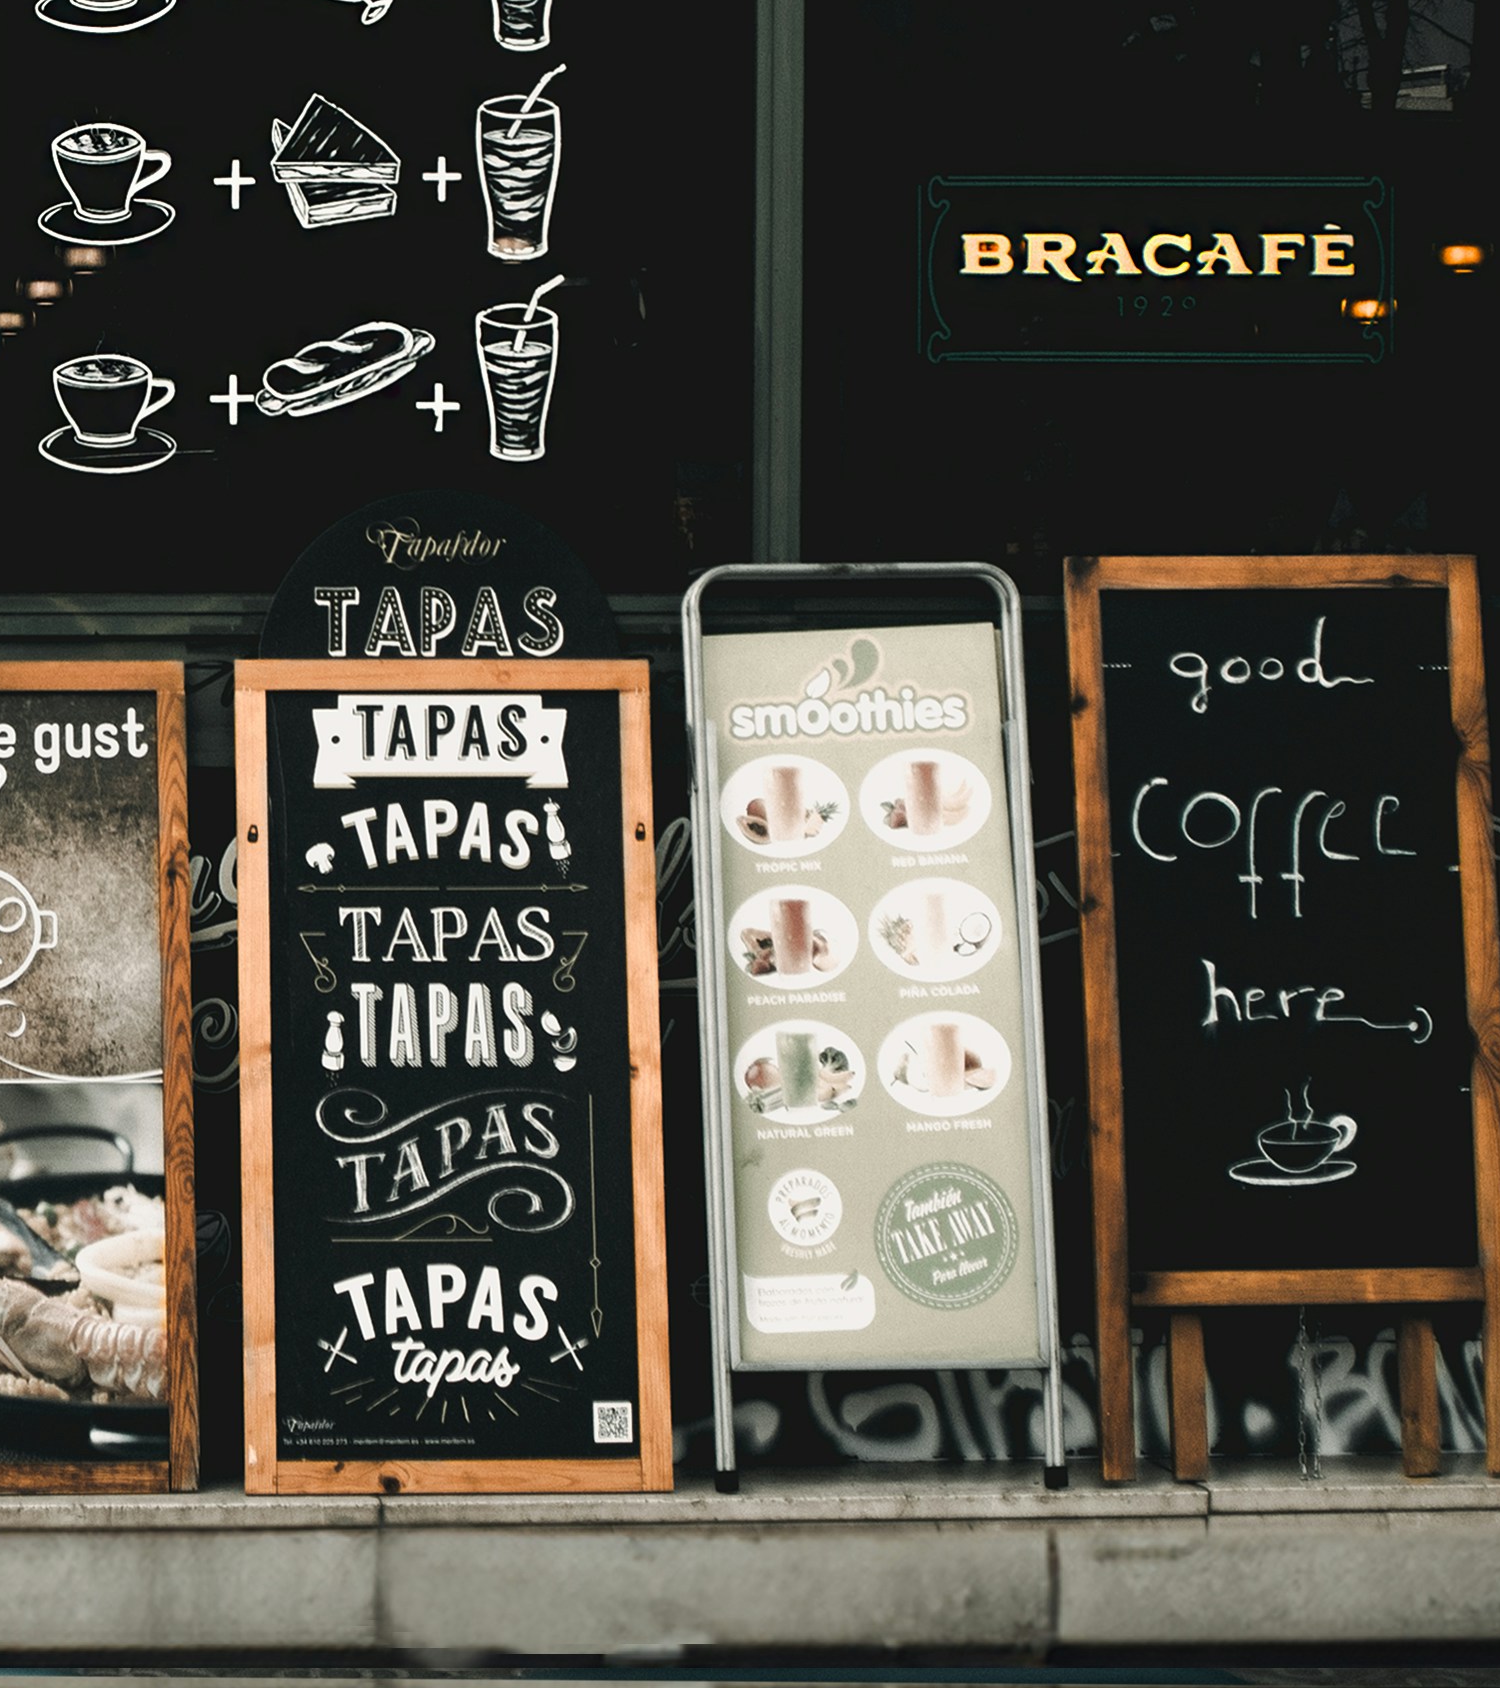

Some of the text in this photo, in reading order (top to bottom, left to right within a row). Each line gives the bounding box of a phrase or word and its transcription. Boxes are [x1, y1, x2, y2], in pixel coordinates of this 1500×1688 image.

[313, 586, 564, 658] TAPAS
[1170, 616, 1374, 714] good
[34, 707, 148, 774] gust
[353, 703, 528, 762] TAPAS
[731, 685, 968, 740] smoothies
[340, 799, 539, 870] TAPAS
[892, 853, 969, 867] RED BANANA
[755, 862, 797, 873] TROPIC
[339, 906, 555, 962] TAPAS
[747, 992, 846, 1006] PEACH PARADISE
[899, 984, 980, 998] PIÑA COLADA
[1201, 958, 1361, 1027] here
[350, 982, 534, 1068] TAPAS
[757, 1126, 854, 1140] NATURAL GREEN
[906, 1118, 992, 1132] MANGO FRESH
[336, 1102, 562, 1214] TAPAS
[891, 1200, 996, 1266] TAKE AWAY
[333, 1263, 559, 1342] TAPAS
[391, 1336, 521, 1398] tapas
